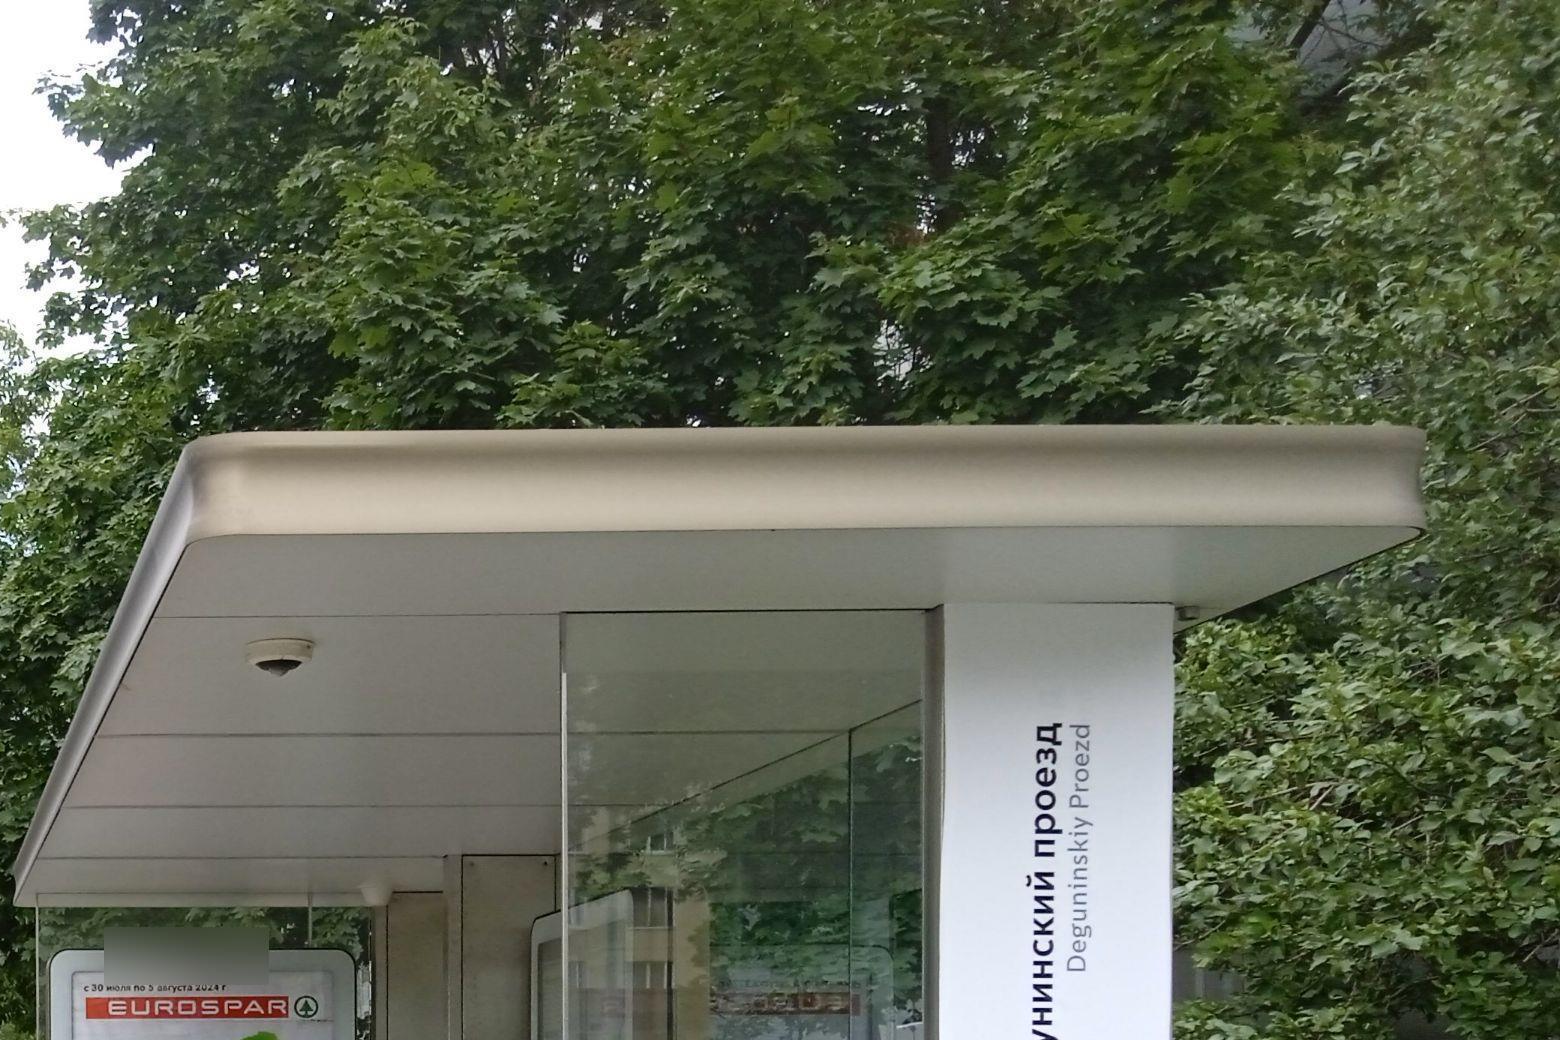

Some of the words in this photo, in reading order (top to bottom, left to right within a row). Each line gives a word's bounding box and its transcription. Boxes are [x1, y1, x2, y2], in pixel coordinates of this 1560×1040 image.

[1034, 722, 1062, 858] проезд
[1068, 723, 1091, 809] Proezd
[1066, 815, 1093, 973] Deguninskiy
[91, 984, 104, 992] 30
[107, 999, 288, 1016] EUROSPAR
